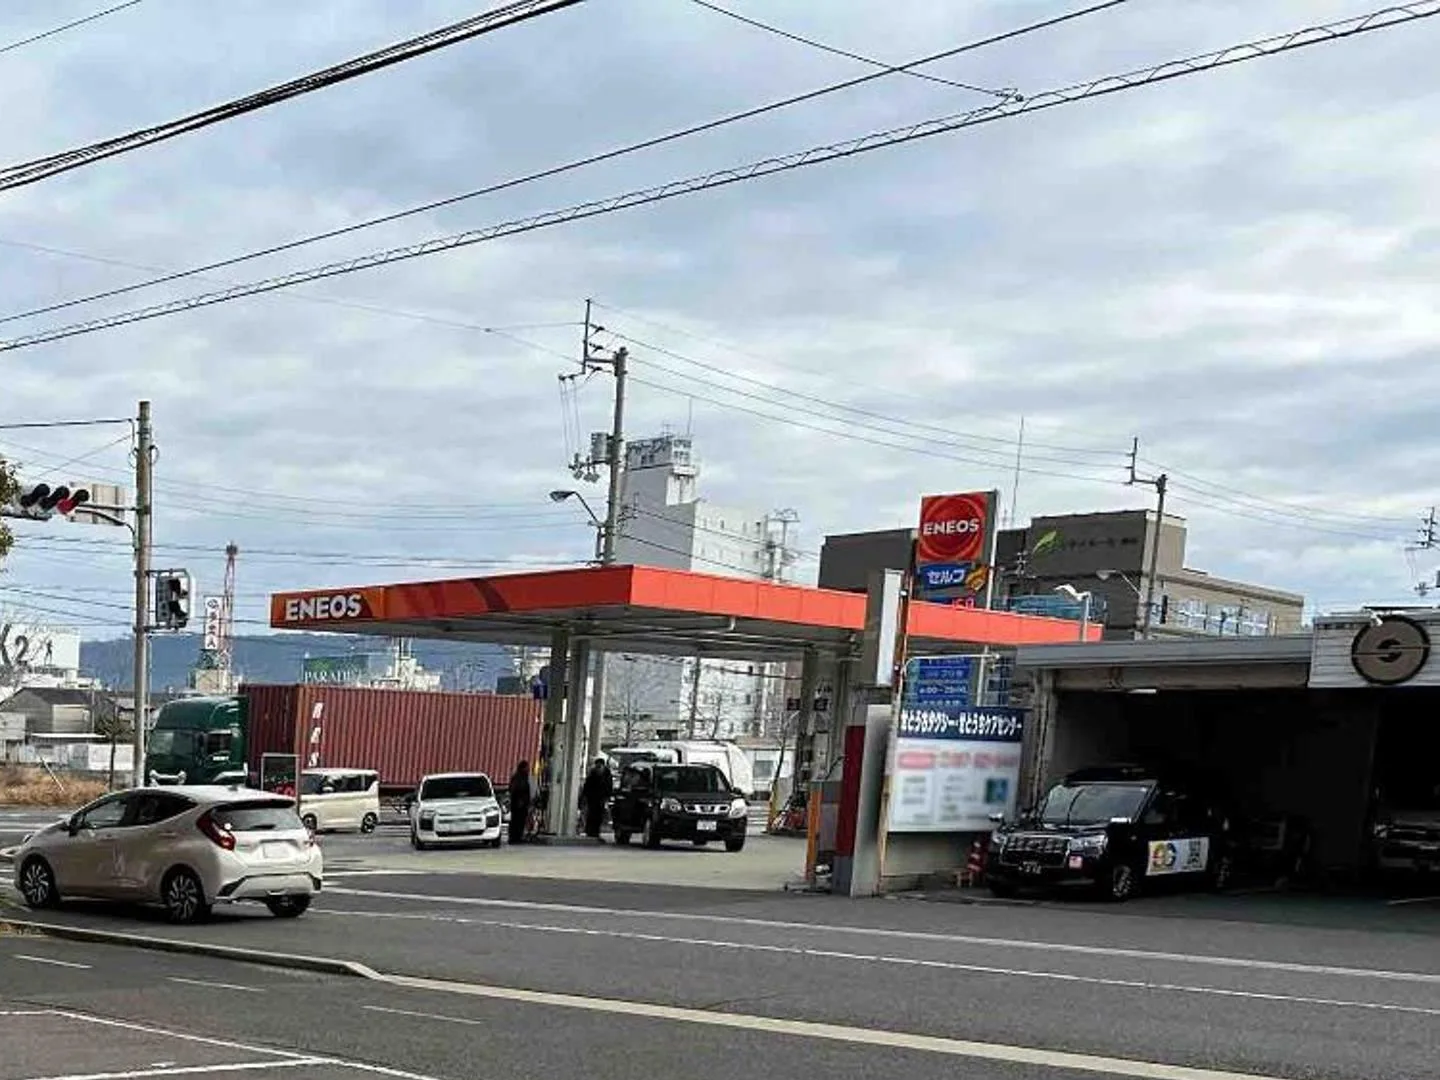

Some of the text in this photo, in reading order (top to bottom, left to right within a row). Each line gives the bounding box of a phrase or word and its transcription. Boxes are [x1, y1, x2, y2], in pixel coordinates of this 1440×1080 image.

[923, 518, 980, 535] ENEOS
[927, 569, 966, 585] セルフ
[285, 594, 362, 622] ENEOS
